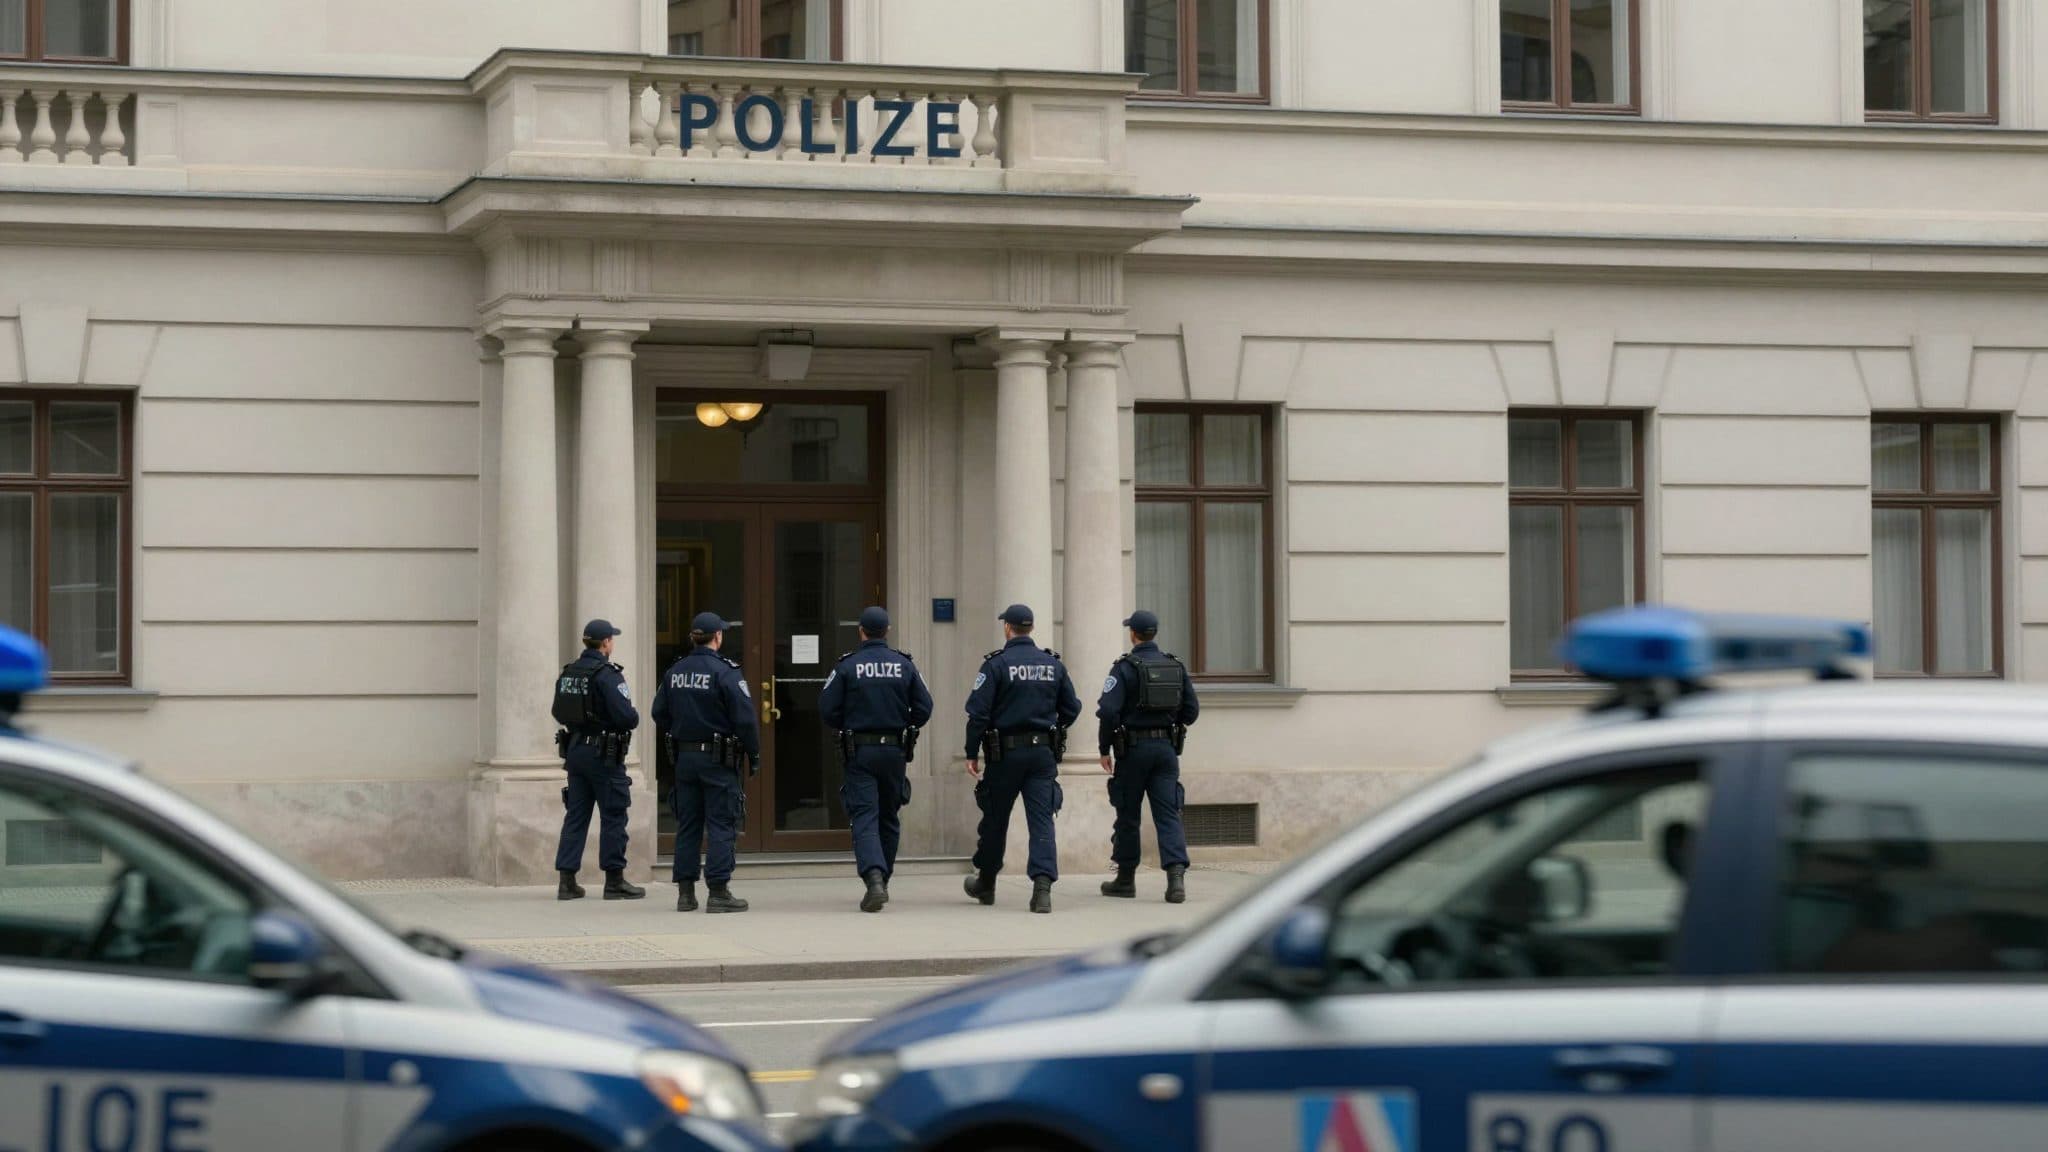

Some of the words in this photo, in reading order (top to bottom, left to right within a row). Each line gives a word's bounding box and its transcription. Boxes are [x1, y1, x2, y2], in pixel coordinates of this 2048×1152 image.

[680, 94, 960, 157] POLIZE
[671, 672, 710, 689] POLIZE
[856, 663, 902, 678] POLIZE
[0, 1083, 211, 1152] IOE
